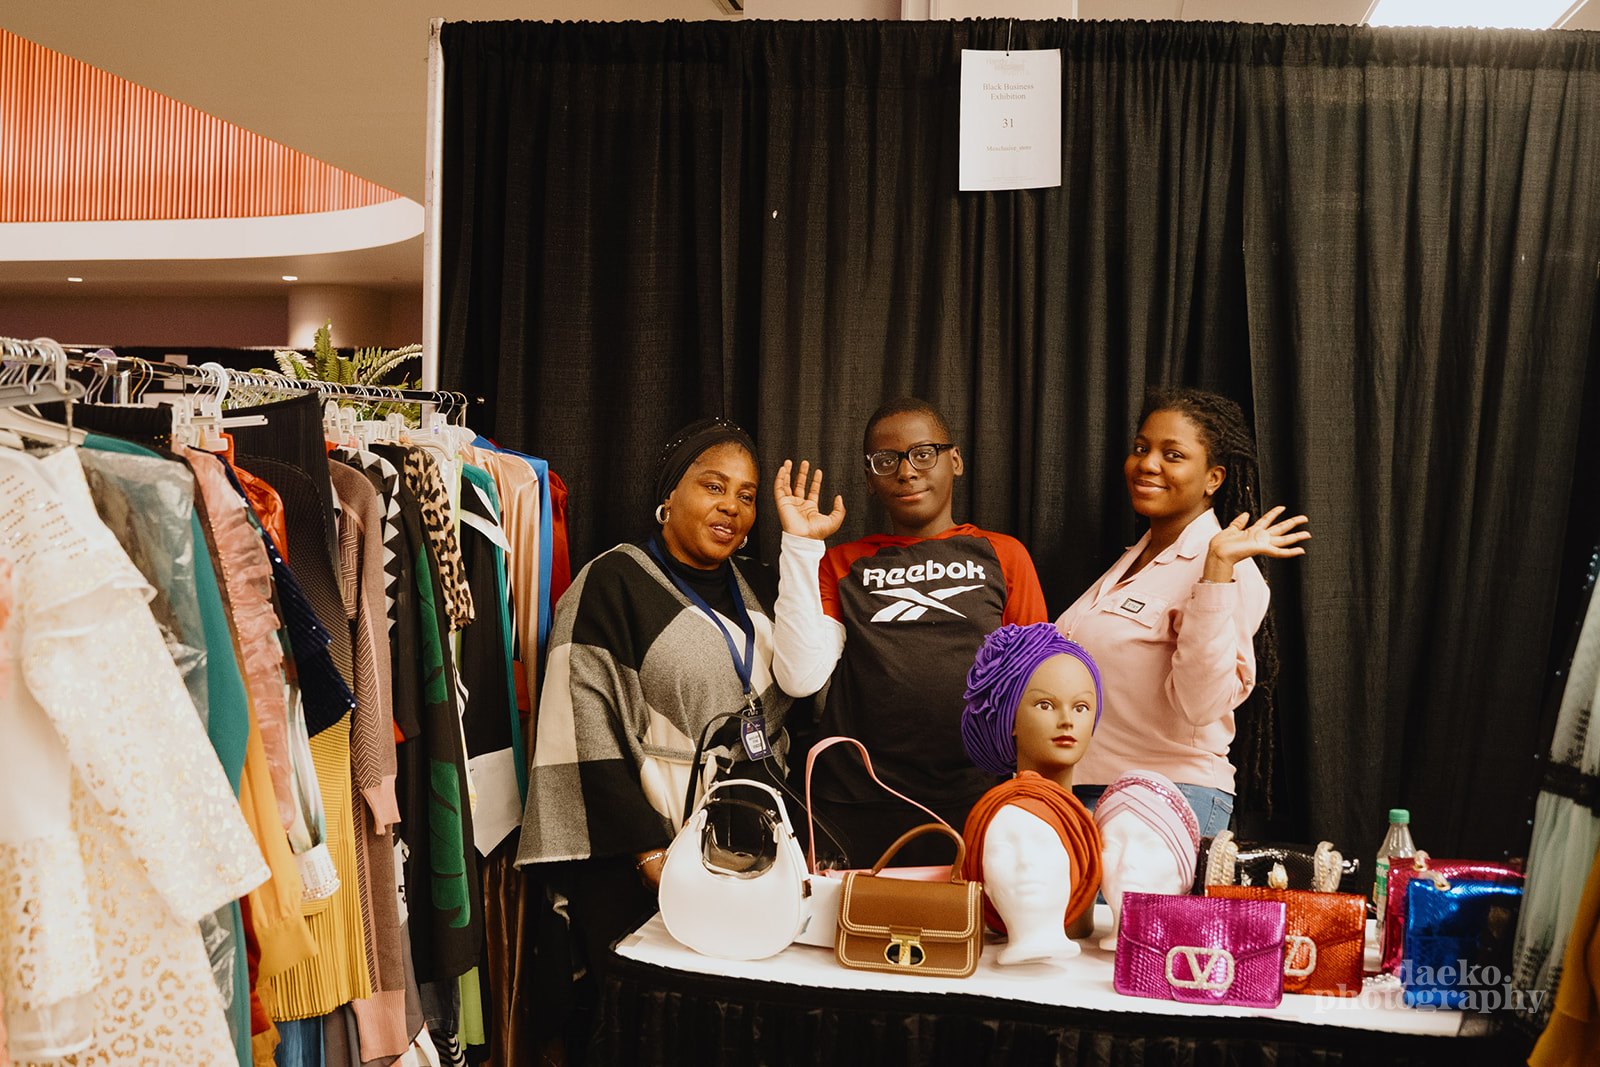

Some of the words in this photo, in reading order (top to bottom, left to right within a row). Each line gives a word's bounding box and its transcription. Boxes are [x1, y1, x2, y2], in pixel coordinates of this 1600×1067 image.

[983, 82, 1002, 91] Black
[1003, 82, 1034, 91] Business
[990, 92, 1026, 101] Exhibition
[1002, 117, 1014, 129] 31
[862, 559, 987, 588] Reebok
